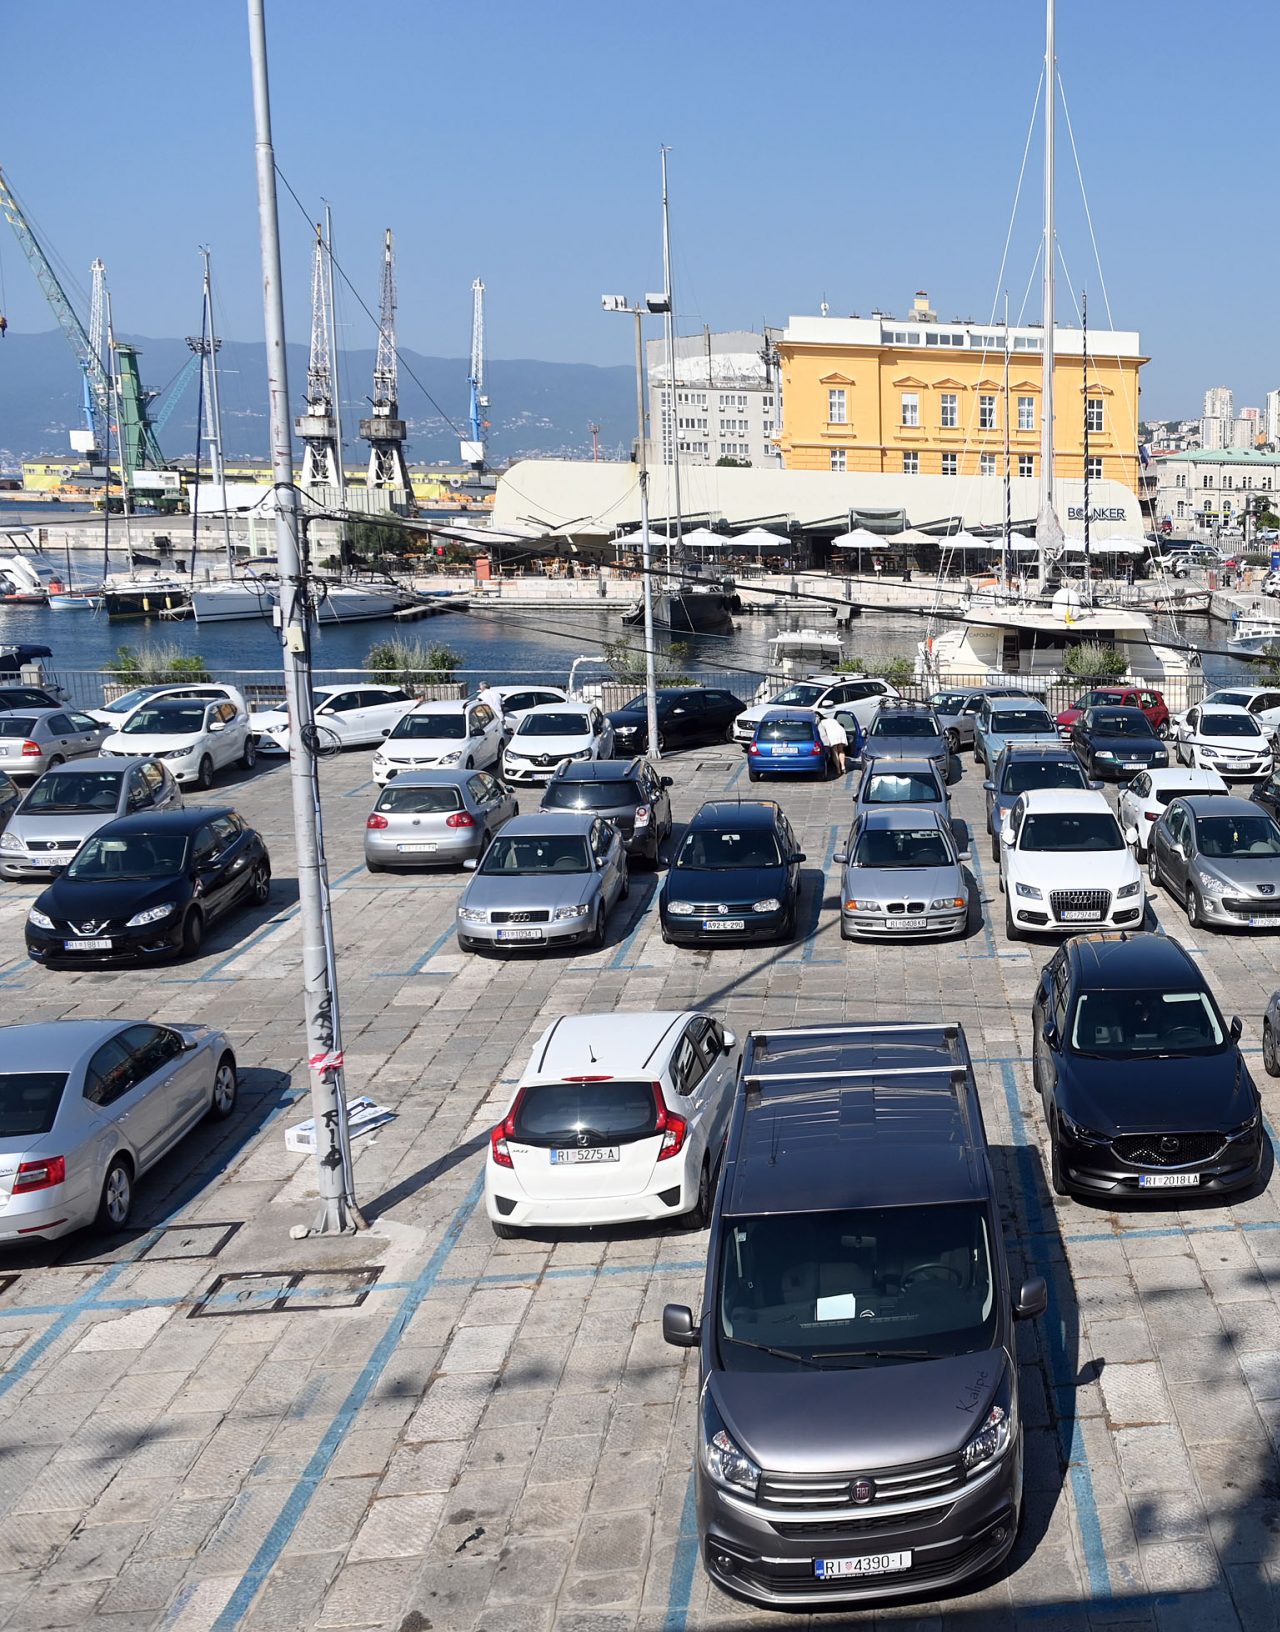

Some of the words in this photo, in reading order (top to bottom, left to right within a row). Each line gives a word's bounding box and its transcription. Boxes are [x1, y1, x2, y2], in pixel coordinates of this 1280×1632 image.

[558, 1151, 569, 1162] RI
[577, 1148, 614, 1161] 5275-A
[1145, 1176, 1156, 1186] RI
[855, 1486, 869, 1498] FIAT
[825, 1560, 842, 1574] RI
[853, 1553, 903, 1572] 4390-I
